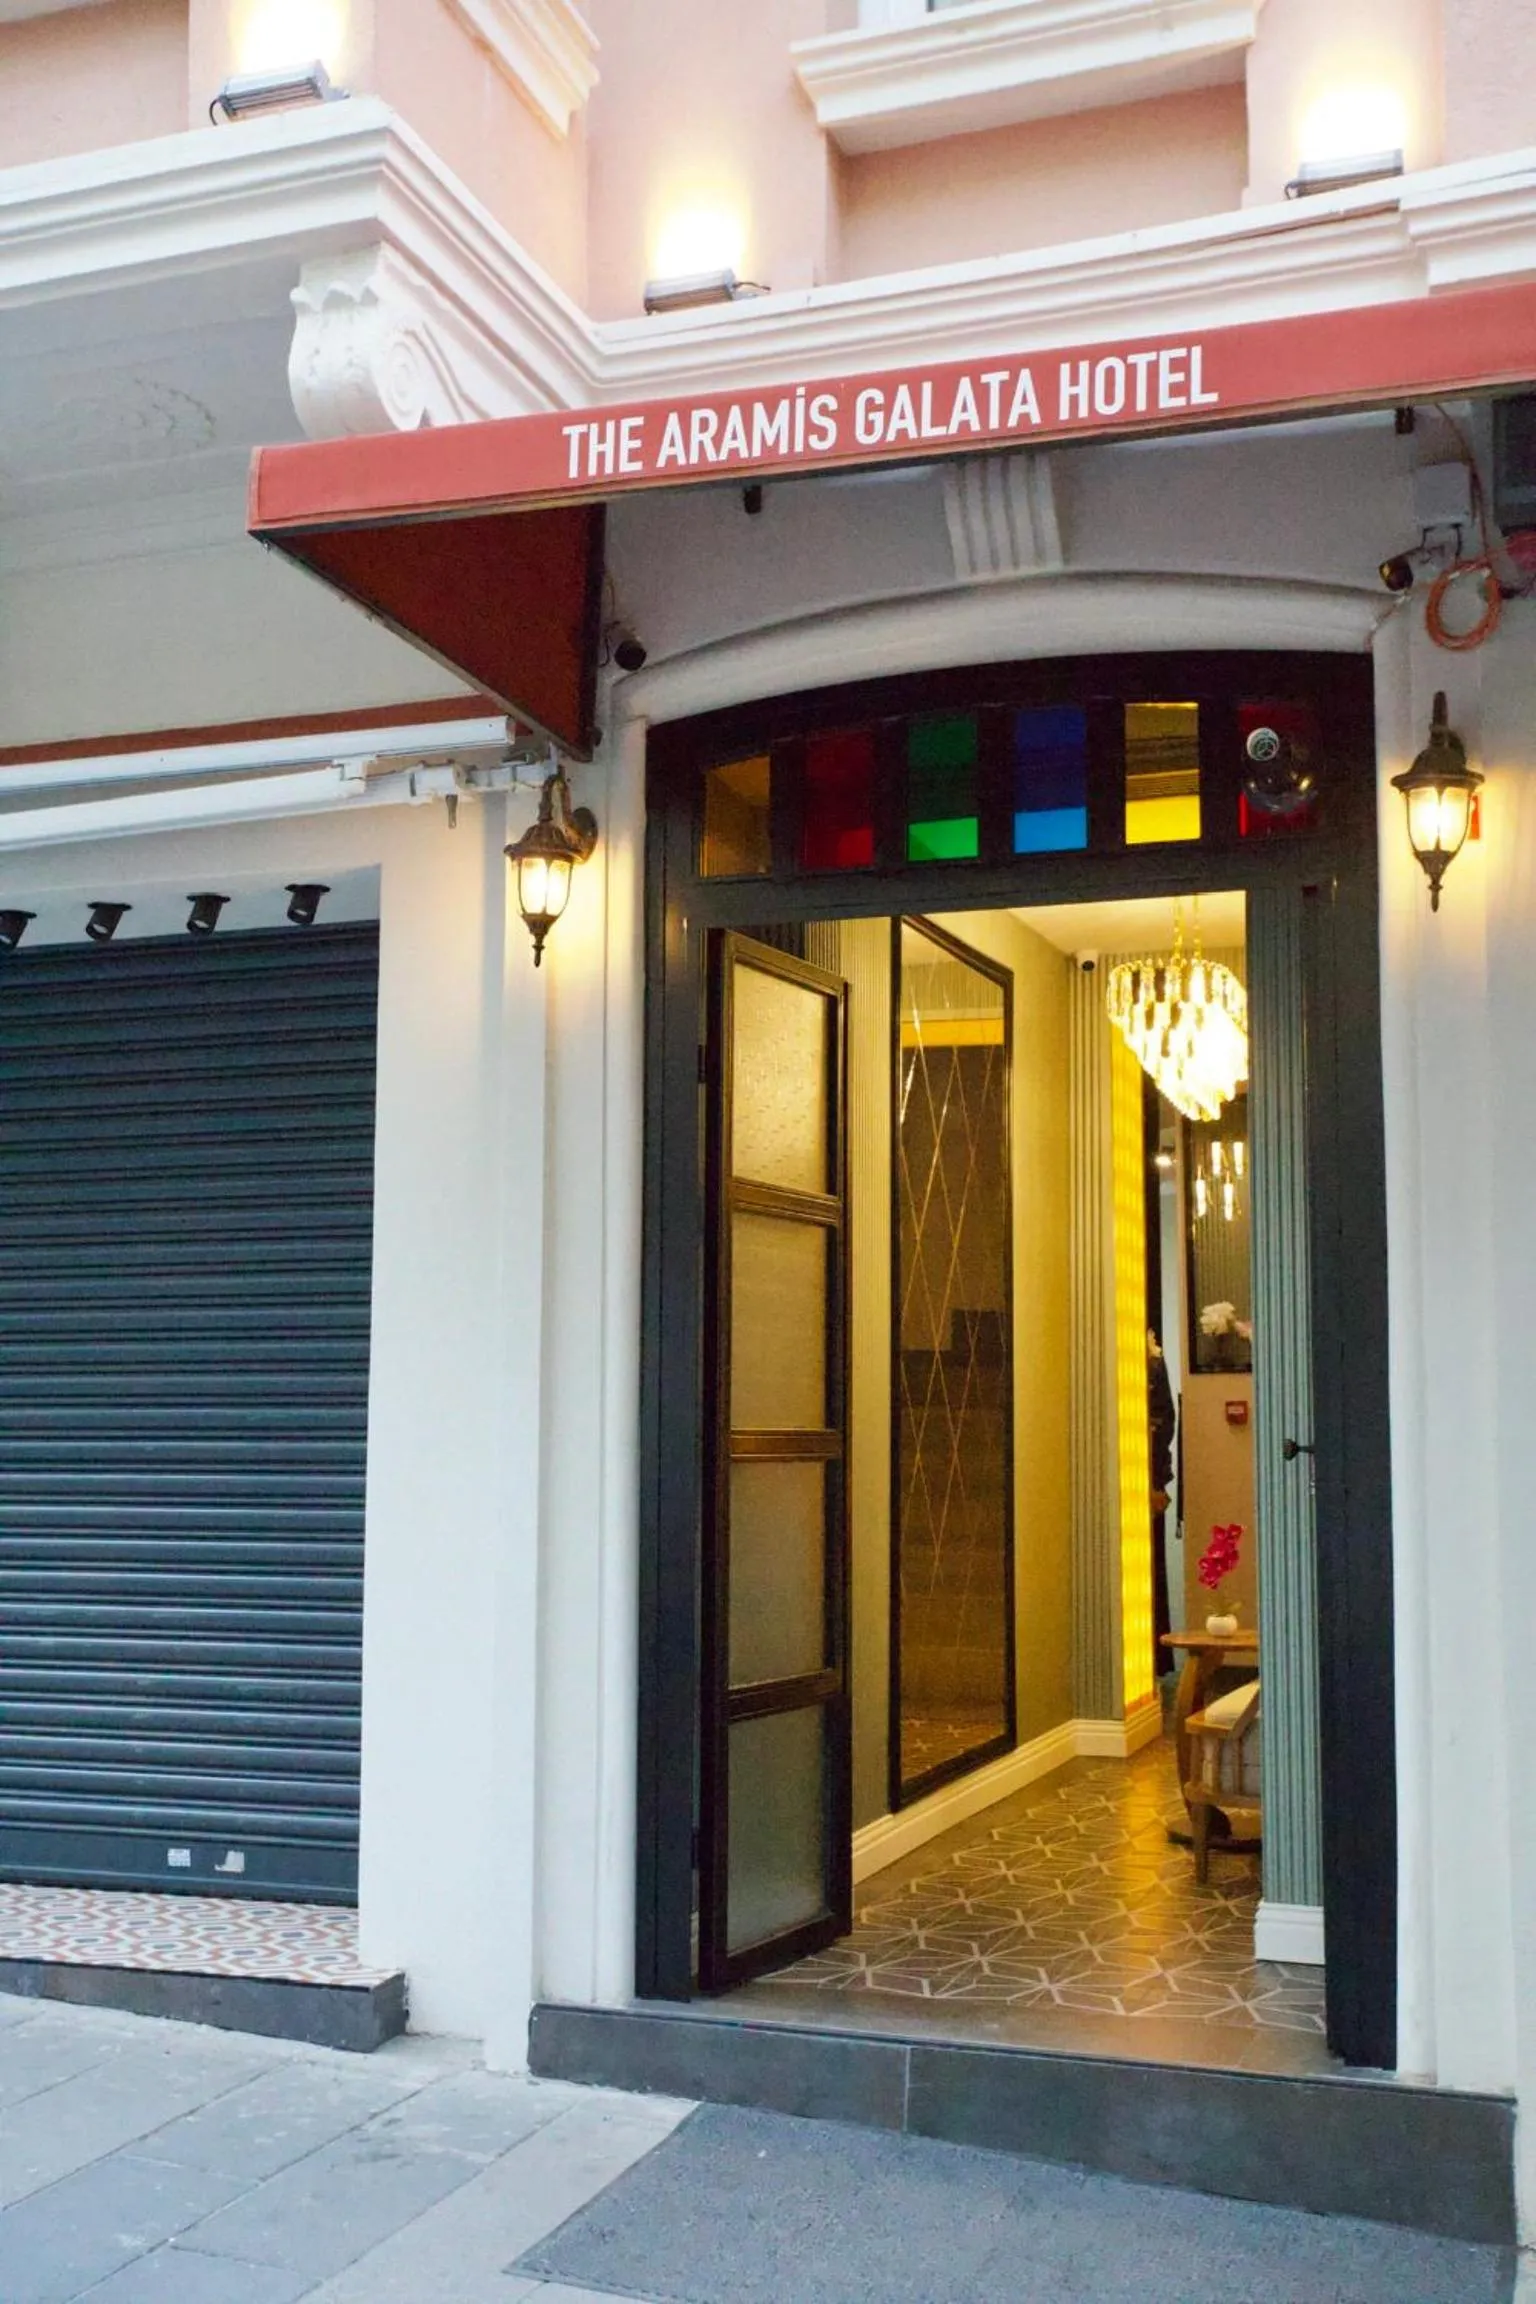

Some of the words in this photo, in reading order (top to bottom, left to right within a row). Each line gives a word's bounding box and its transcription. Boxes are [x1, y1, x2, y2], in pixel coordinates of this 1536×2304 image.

[562, 416, 644, 478] THE
[656, 386, 838, 467] ARAMİS
[854, 368, 1041, 445] GALATA
[1058, 345, 1219, 420] HOTEL
